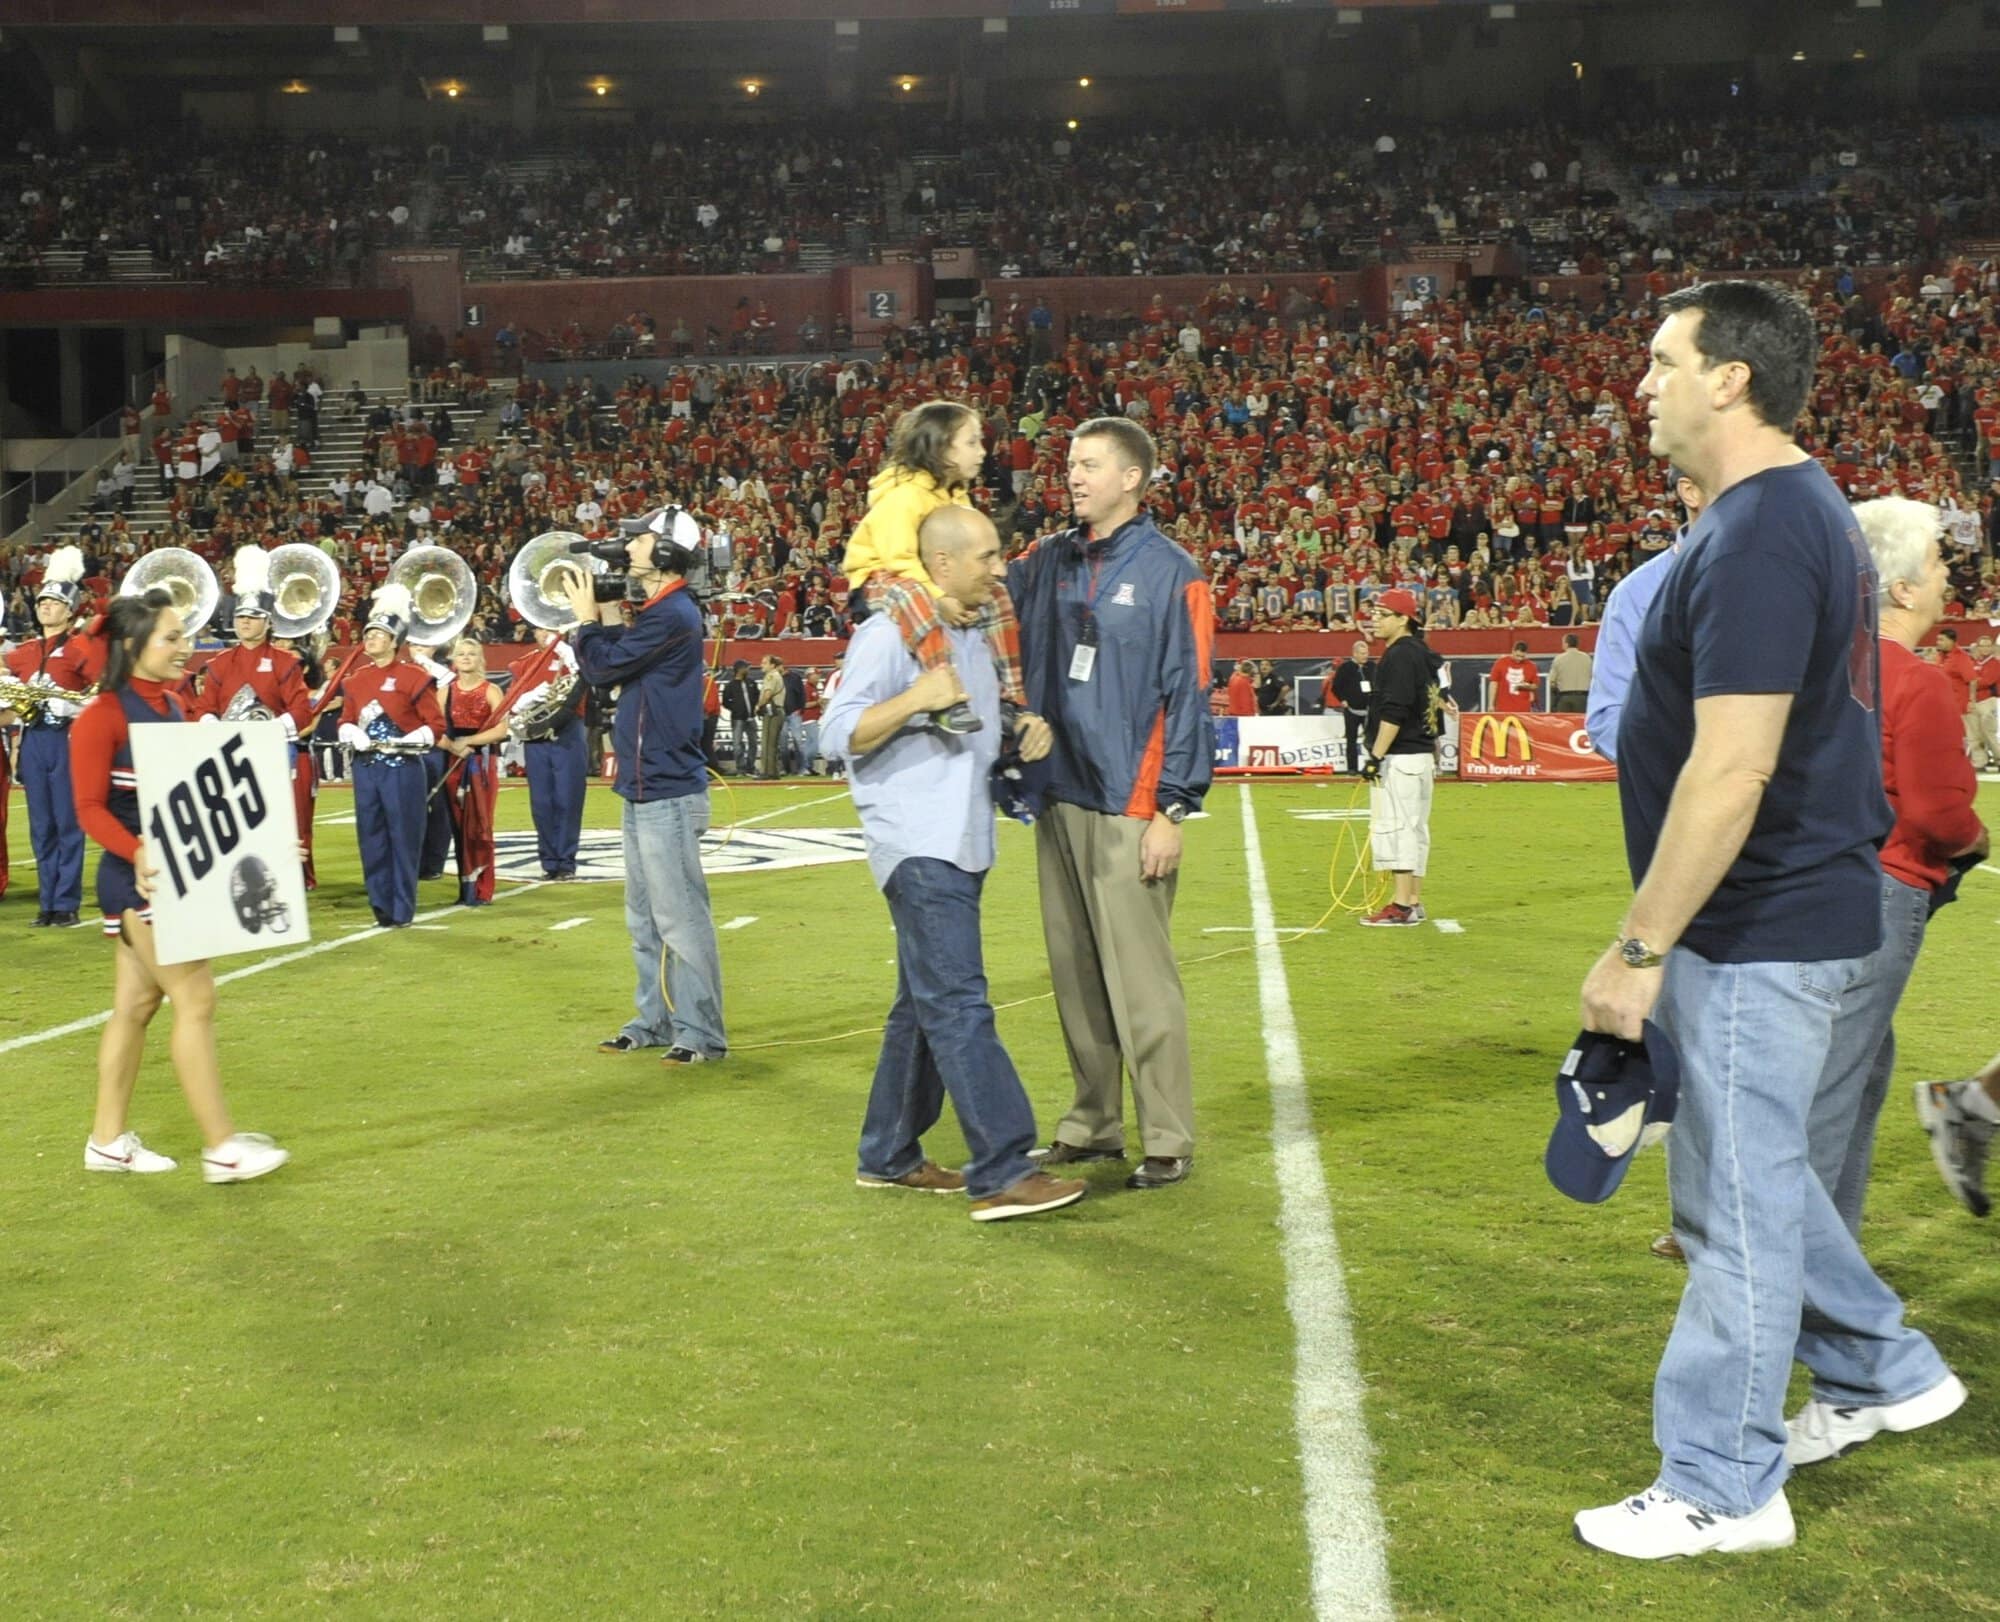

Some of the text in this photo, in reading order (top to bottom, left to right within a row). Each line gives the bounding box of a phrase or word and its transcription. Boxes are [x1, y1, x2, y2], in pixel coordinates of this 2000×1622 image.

[1416, 277, 1430, 294] 3
[875, 293, 889, 310] 2
[468, 305, 477, 321] 1
[1252, 749, 1277, 767] 20
[1489, 763, 1525, 775] lovin'
[149, 731, 267, 900] 1985
